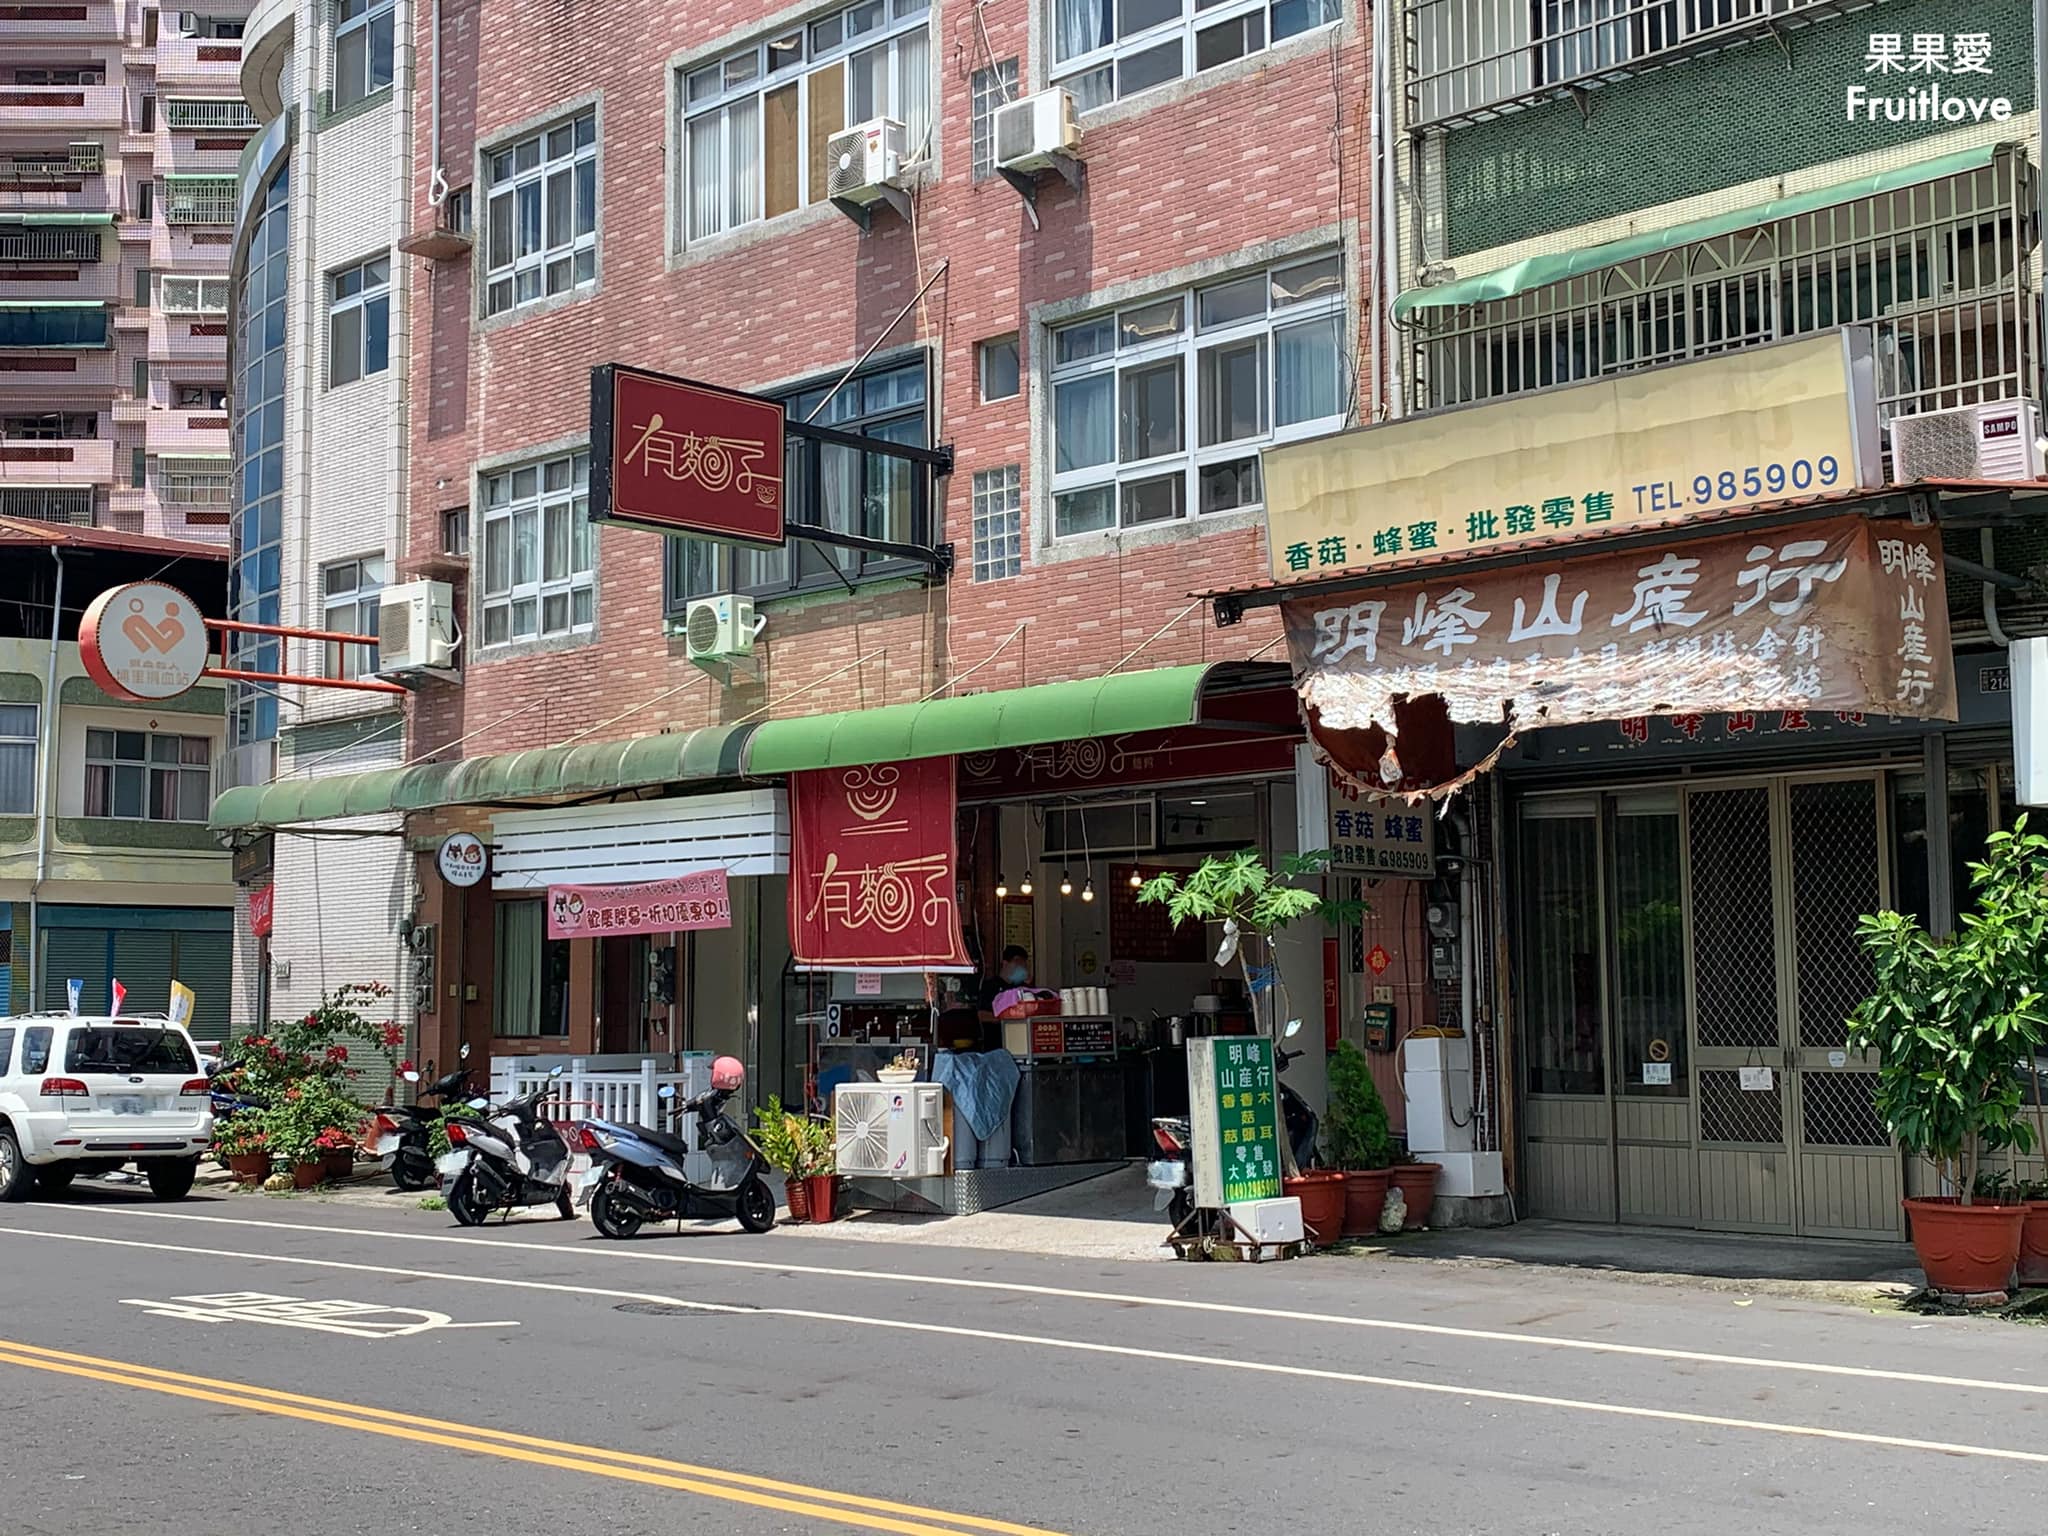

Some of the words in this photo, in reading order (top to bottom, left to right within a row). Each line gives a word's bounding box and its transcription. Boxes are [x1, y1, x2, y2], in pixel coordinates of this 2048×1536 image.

[1984, 420, 2017, 435] SAMPO
[1334, 809, 1374, 839] 香菇
[1384, 815, 1423, 843] 蜂蜜
[1388, 850, 1429, 870] 985909
[1228, 1043, 1261, 1065] 明峰
